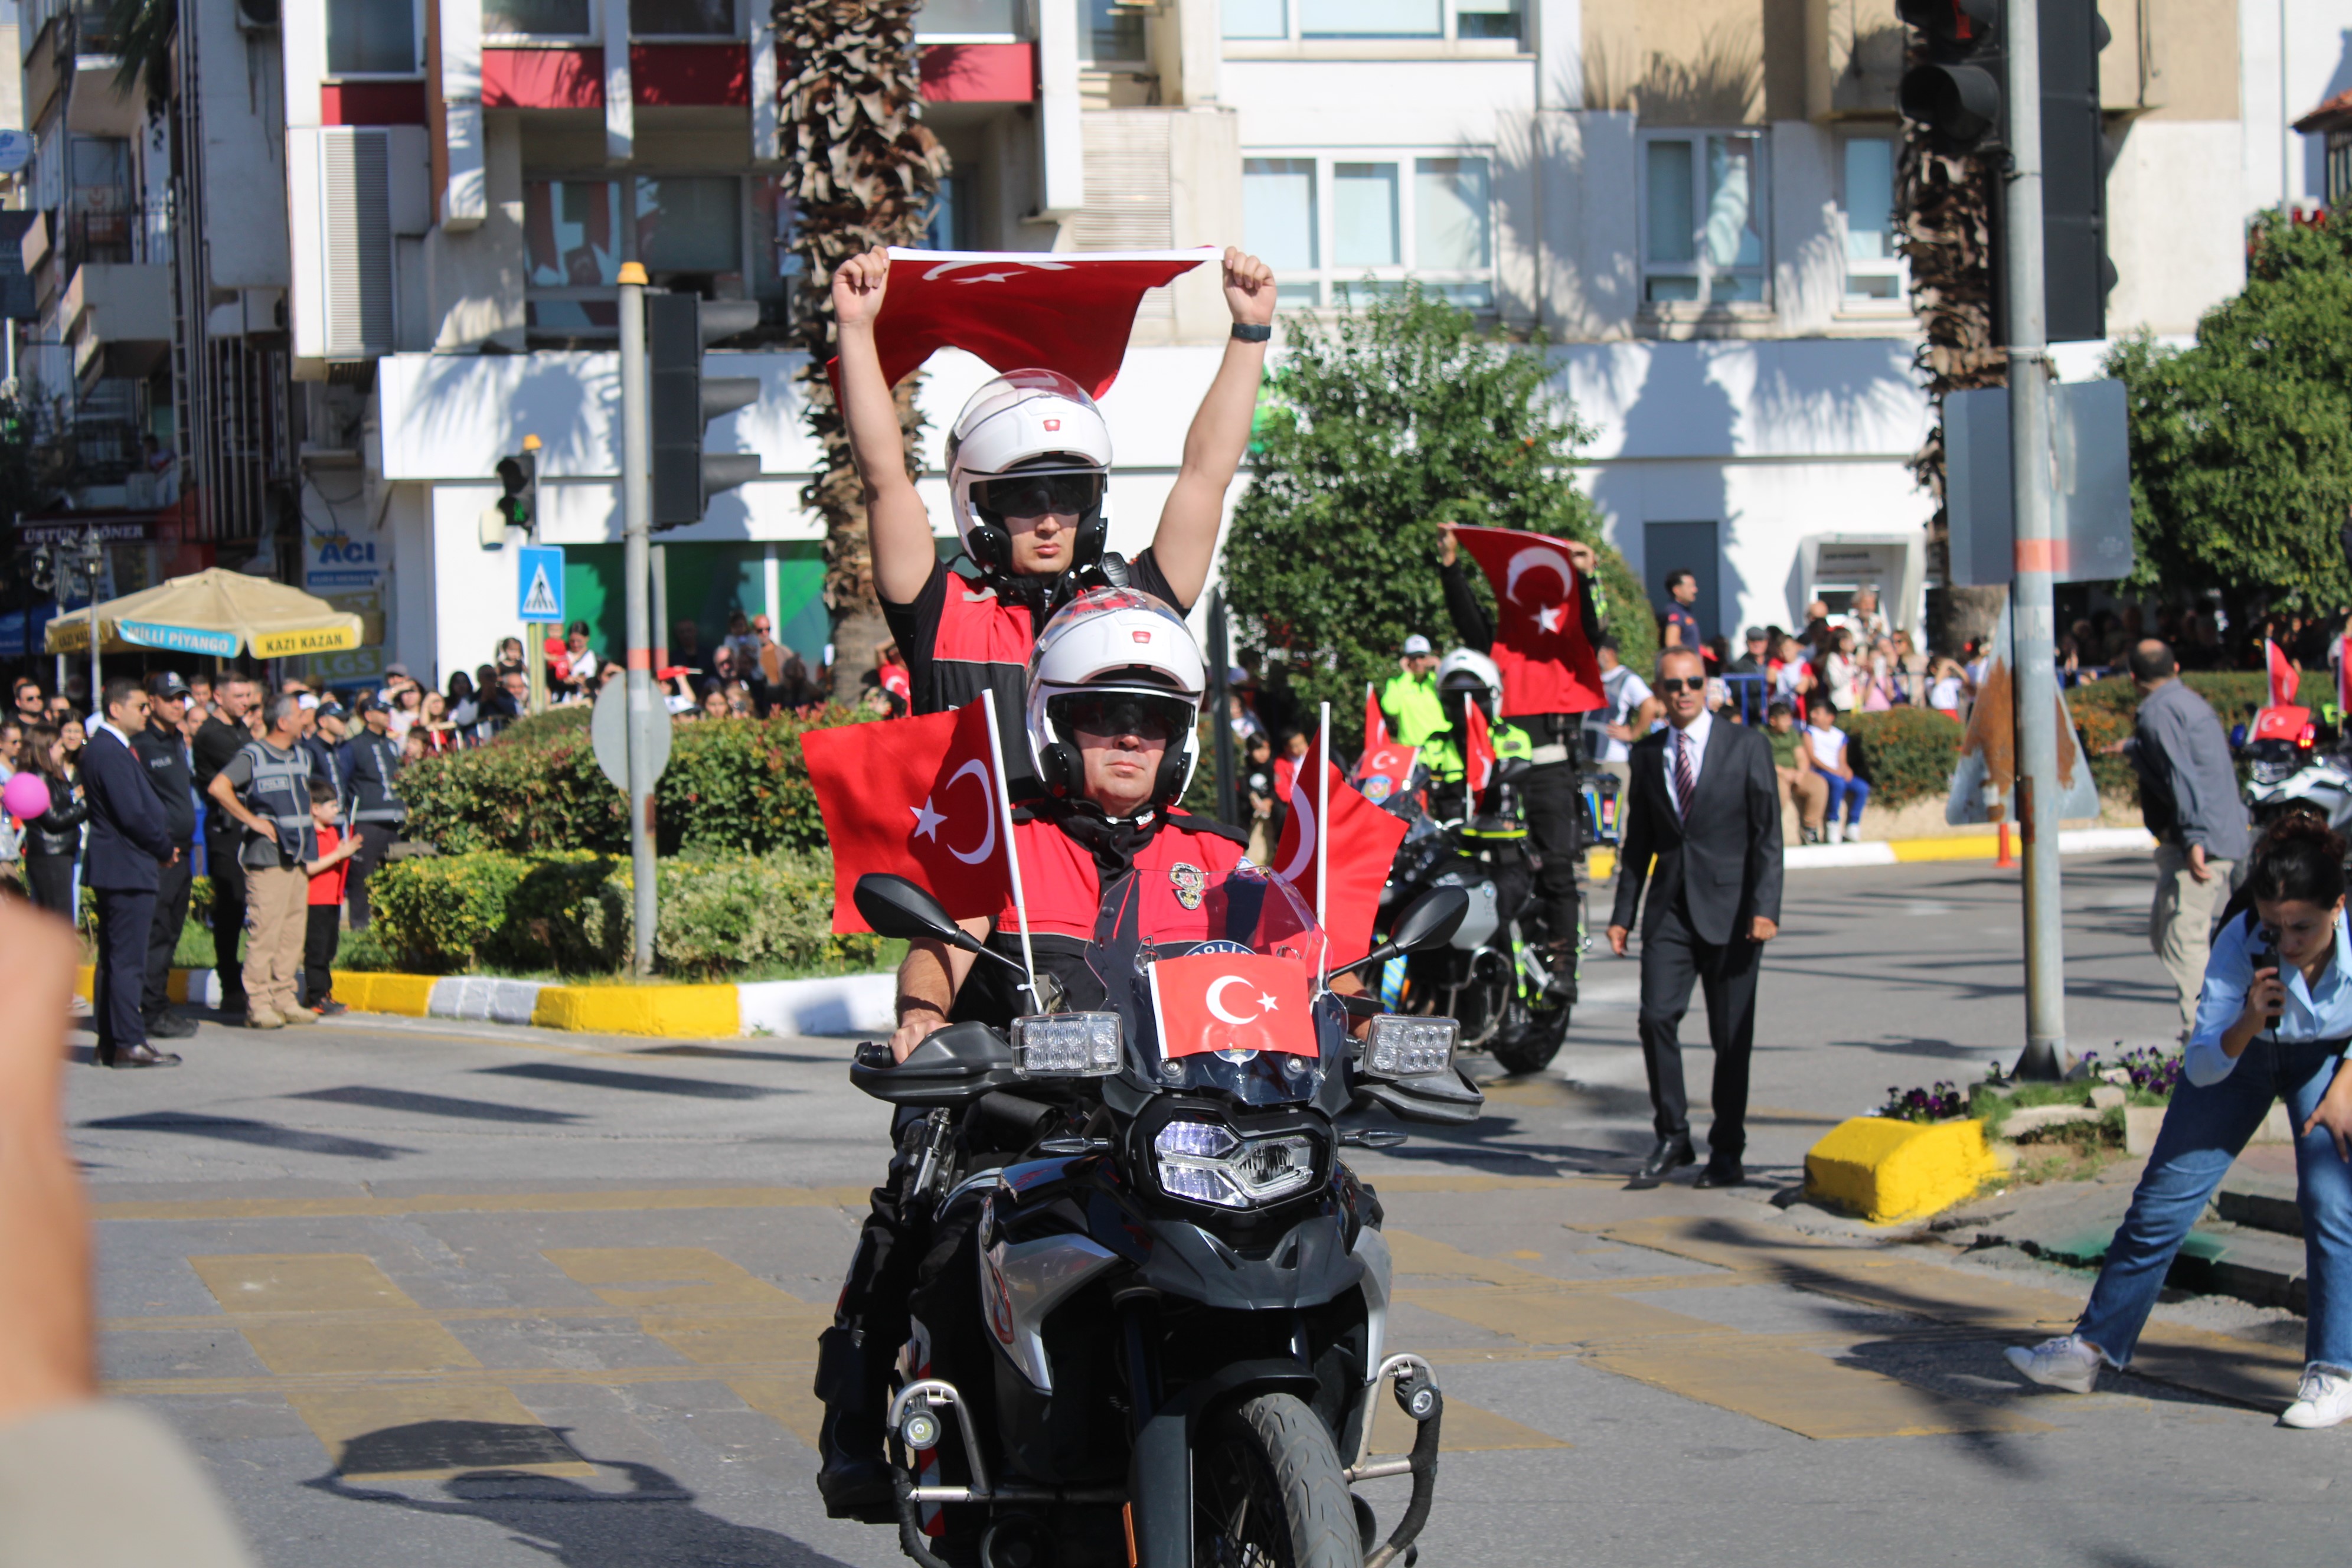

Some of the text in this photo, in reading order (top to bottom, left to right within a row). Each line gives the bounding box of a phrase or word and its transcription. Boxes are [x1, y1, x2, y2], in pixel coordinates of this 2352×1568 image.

[319, 541, 375, 564] ACI
[128, 625, 229, 654] MİLLİ PİYANGO
[266, 632, 342, 653] KAZI KAZAN
[315, 652, 375, 677] LGS
[1191, 943, 1250, 956] OLİ
